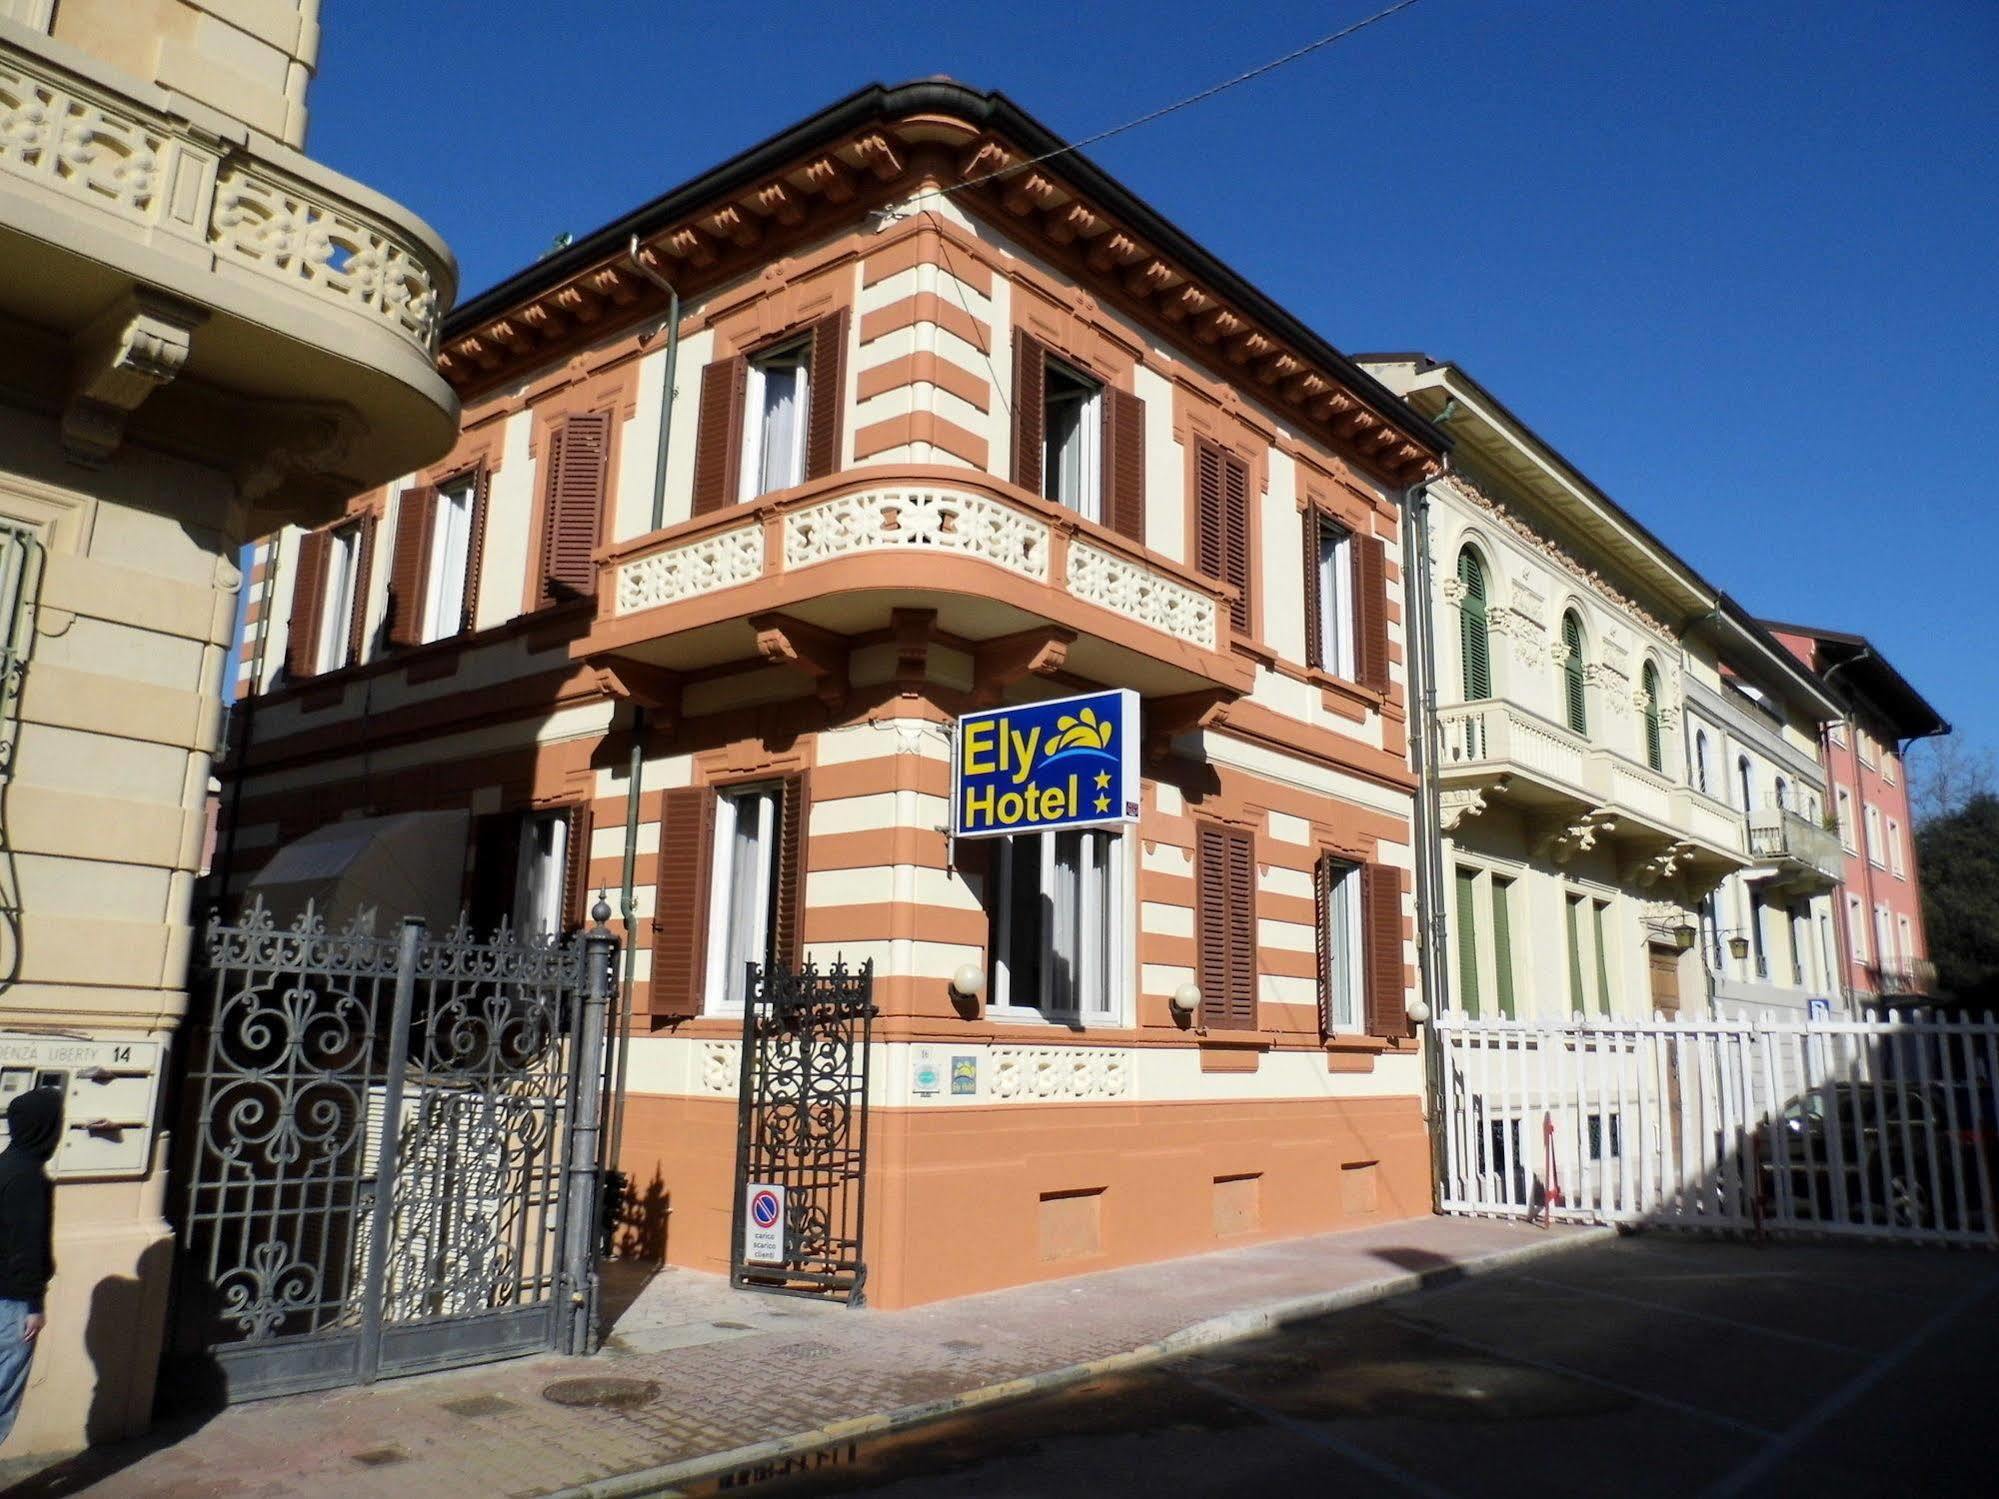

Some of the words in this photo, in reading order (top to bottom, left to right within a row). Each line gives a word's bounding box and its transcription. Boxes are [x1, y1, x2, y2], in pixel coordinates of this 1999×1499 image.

[965, 718, 1040, 784] Ely
[965, 774, 1078, 828] Hotel
[113, 1047, 131, 1062] 14
[755, 1232, 775, 1240] carico
[753, 1242, 776, 1250] scarico
